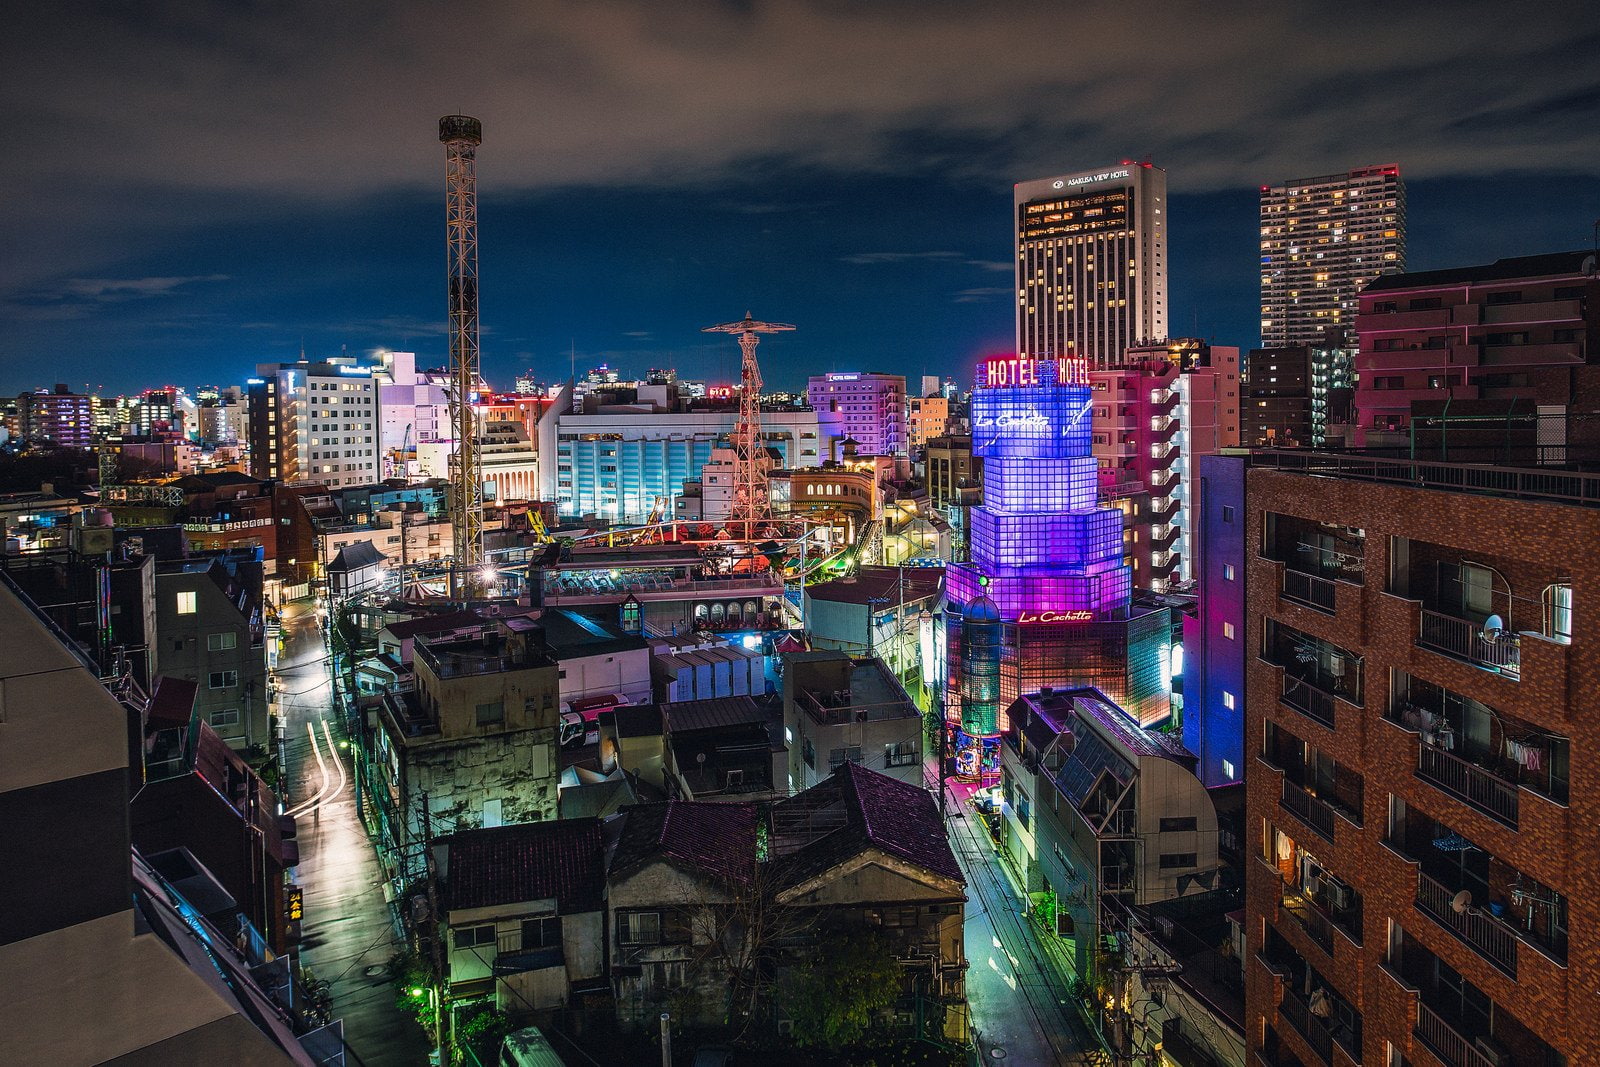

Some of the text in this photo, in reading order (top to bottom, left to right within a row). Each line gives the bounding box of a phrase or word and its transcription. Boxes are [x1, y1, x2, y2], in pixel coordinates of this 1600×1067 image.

[1068, 170, 1129, 186] ASAKUSA VIEW HOTEL
[988, 359, 1038, 385] HOTEL
[1059, 357, 1090, 384] HOTEL
[975, 414, 994, 426] La
[1019, 611, 1092, 622] La Cachette
